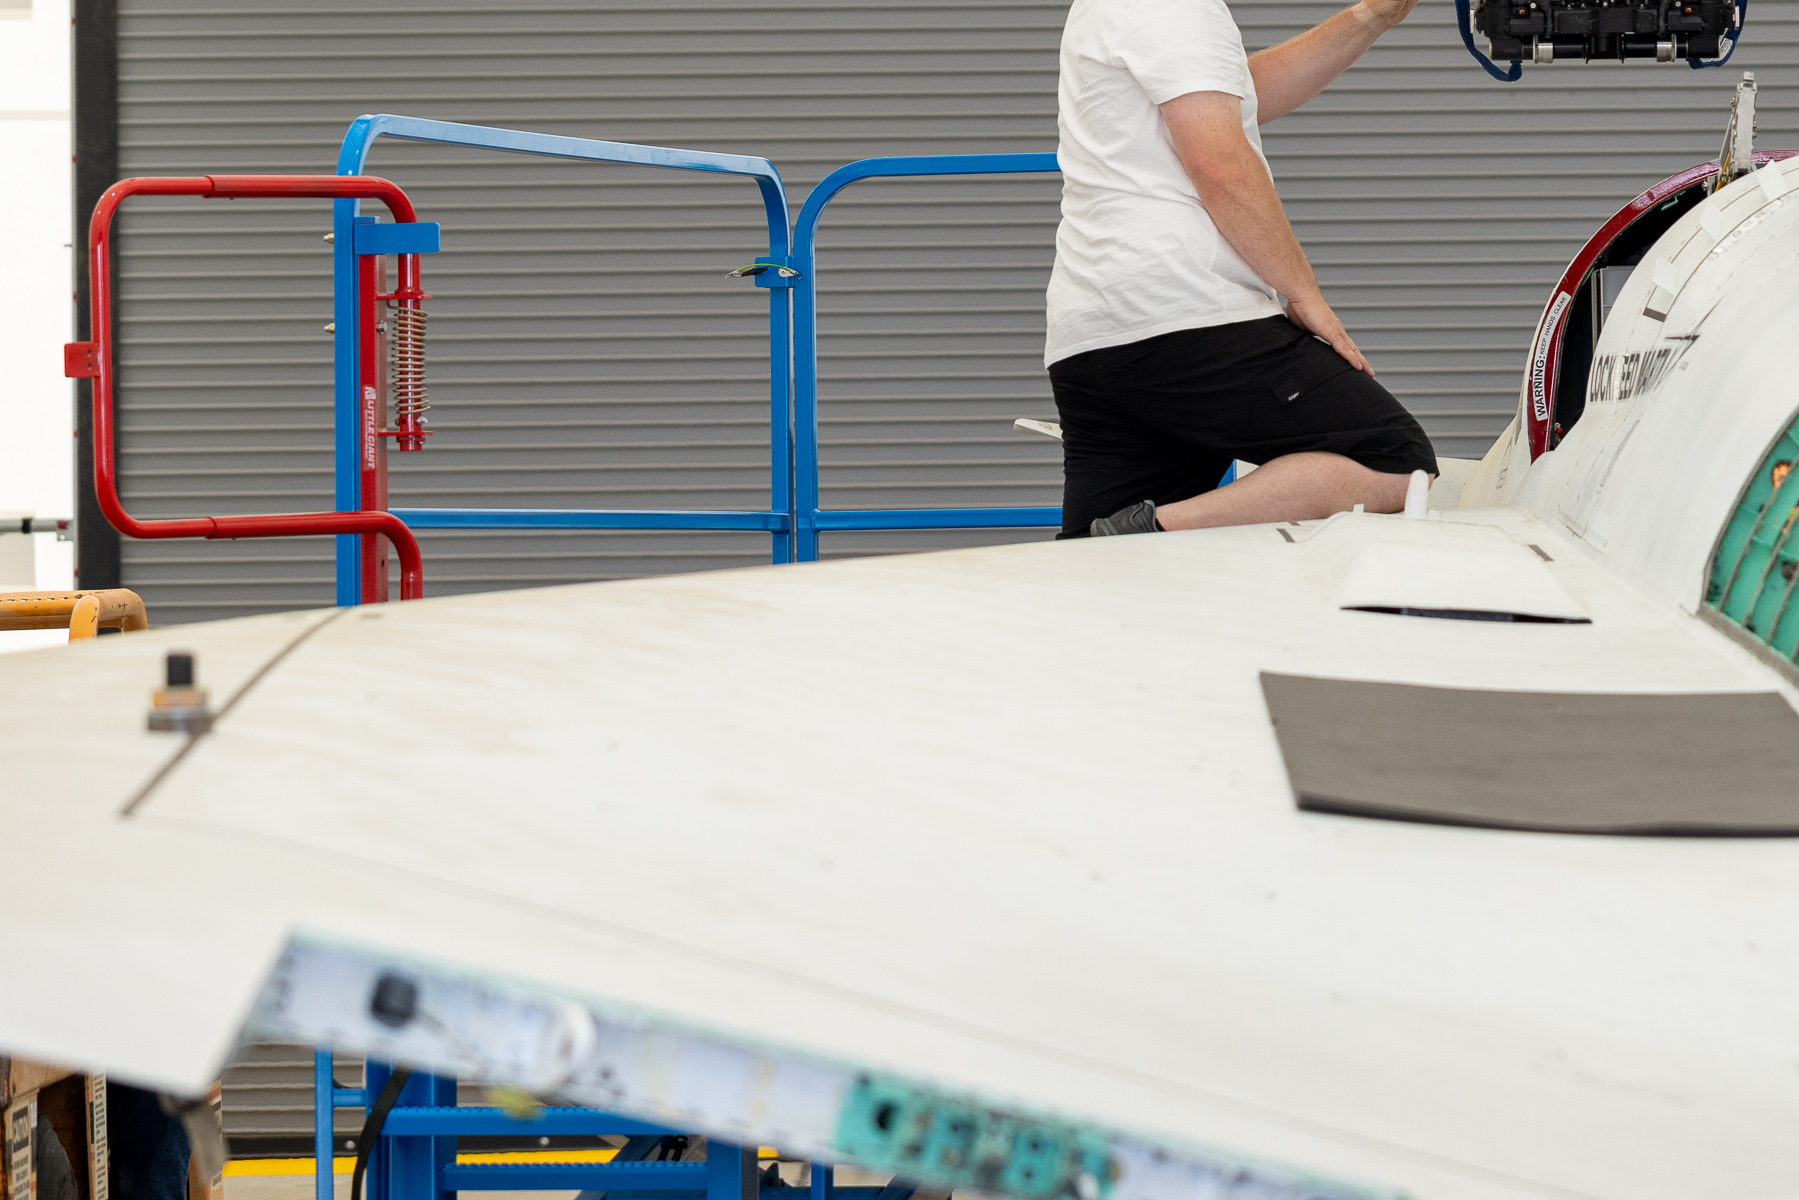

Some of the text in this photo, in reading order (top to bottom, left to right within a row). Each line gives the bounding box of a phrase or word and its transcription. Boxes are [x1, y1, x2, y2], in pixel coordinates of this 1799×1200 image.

[1534, 356, 1546, 417] WARNING:
[1544, 316, 1556, 336] HANDS
[1554, 296, 1567, 314] CLEAR
[1590, 352, 1641, 402] LOCKEED
